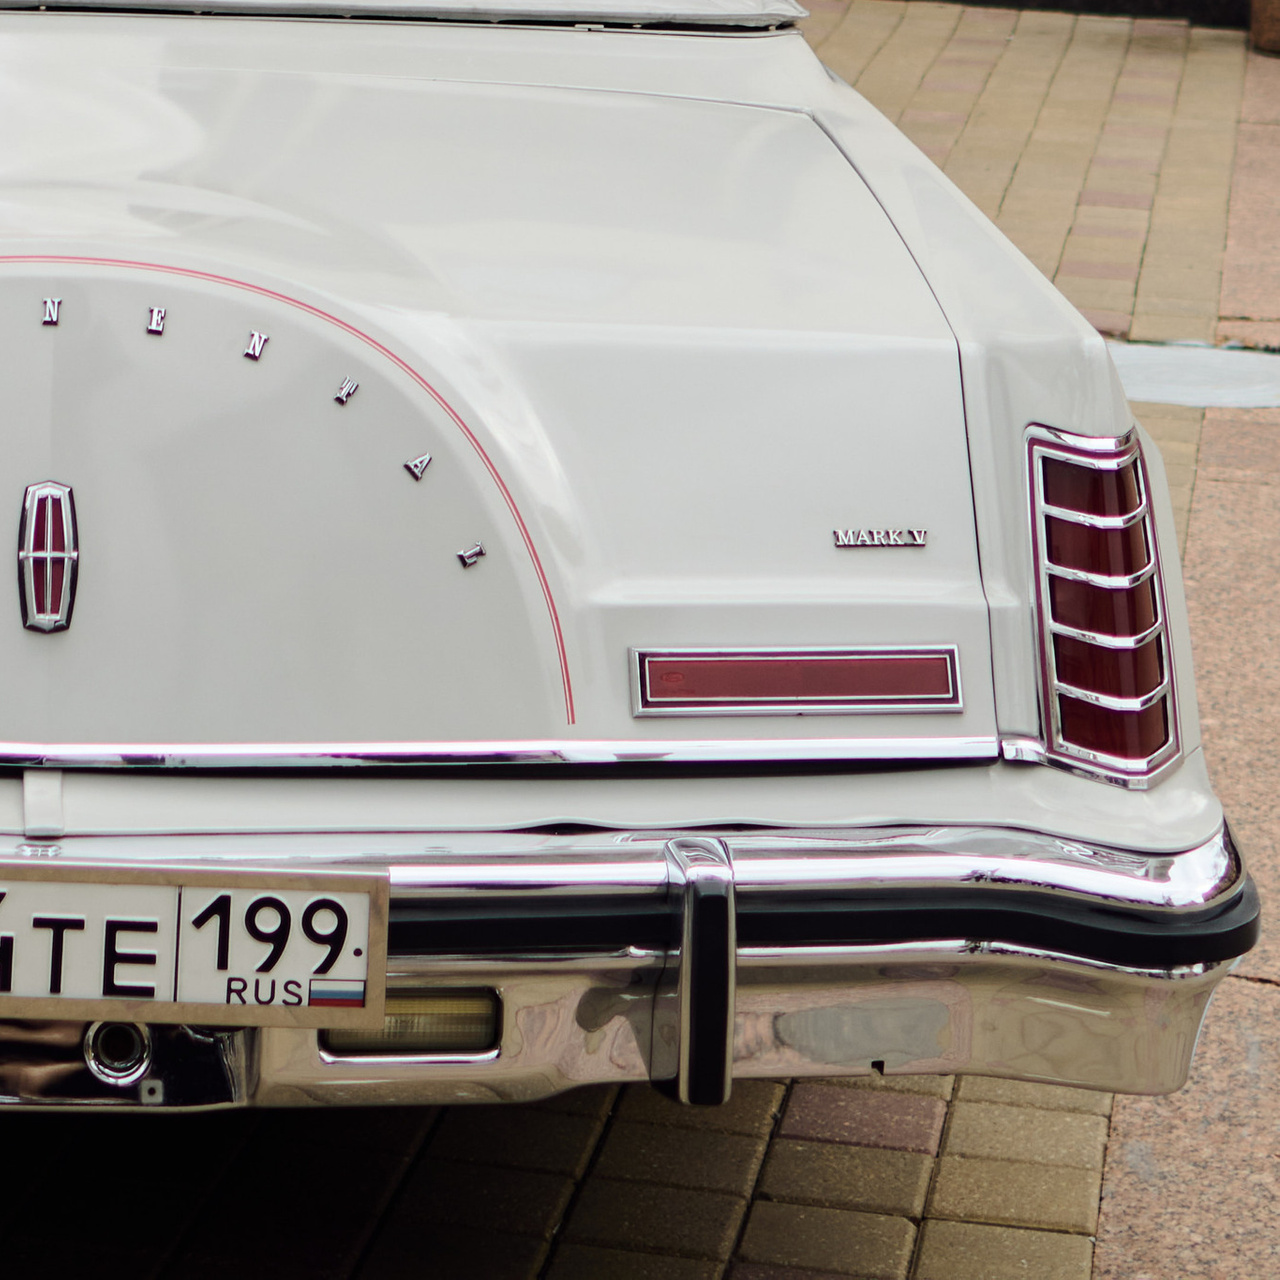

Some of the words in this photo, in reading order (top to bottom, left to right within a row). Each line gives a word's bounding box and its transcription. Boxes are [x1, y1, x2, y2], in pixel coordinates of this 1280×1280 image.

[833, 529, 904, 547] MARK
[907, 529, 927, 547] V
[191, 895, 349, 975] 199
[226, 977, 303, 1006] RUS
